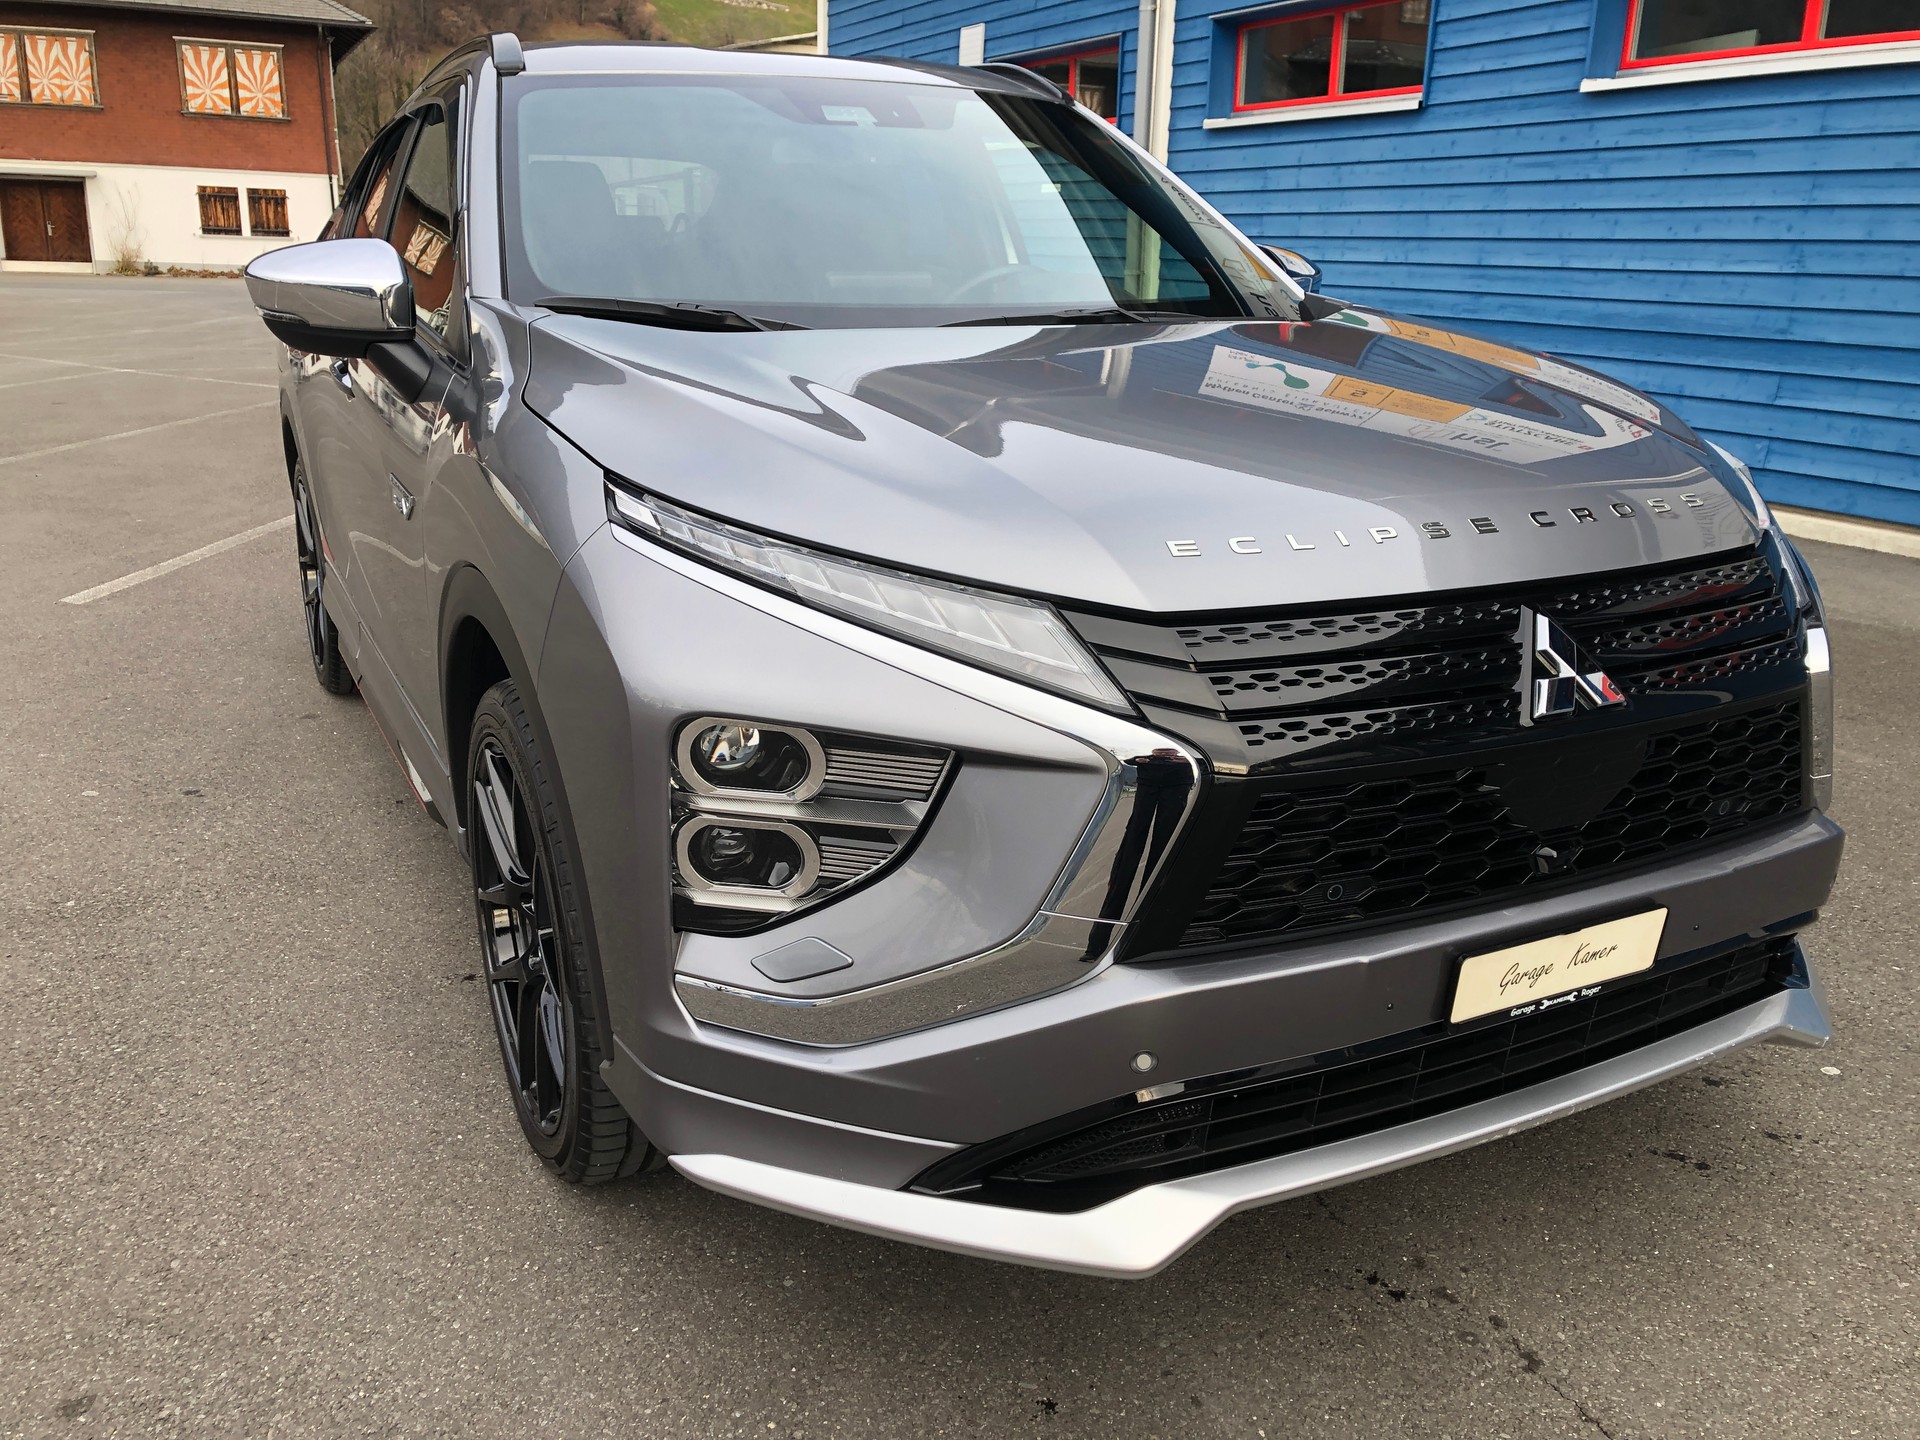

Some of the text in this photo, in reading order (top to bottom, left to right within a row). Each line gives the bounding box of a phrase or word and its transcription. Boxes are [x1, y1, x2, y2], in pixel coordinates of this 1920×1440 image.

[1165, 516, 1500, 558] ECLIPSE
[1529, 492, 1706, 528] CROSS
[1499, 942, 1618, 996] Garage Kamer
[1510, 1004, 1536, 1017] Garage
[1581, 986, 1602, 997] Roger
